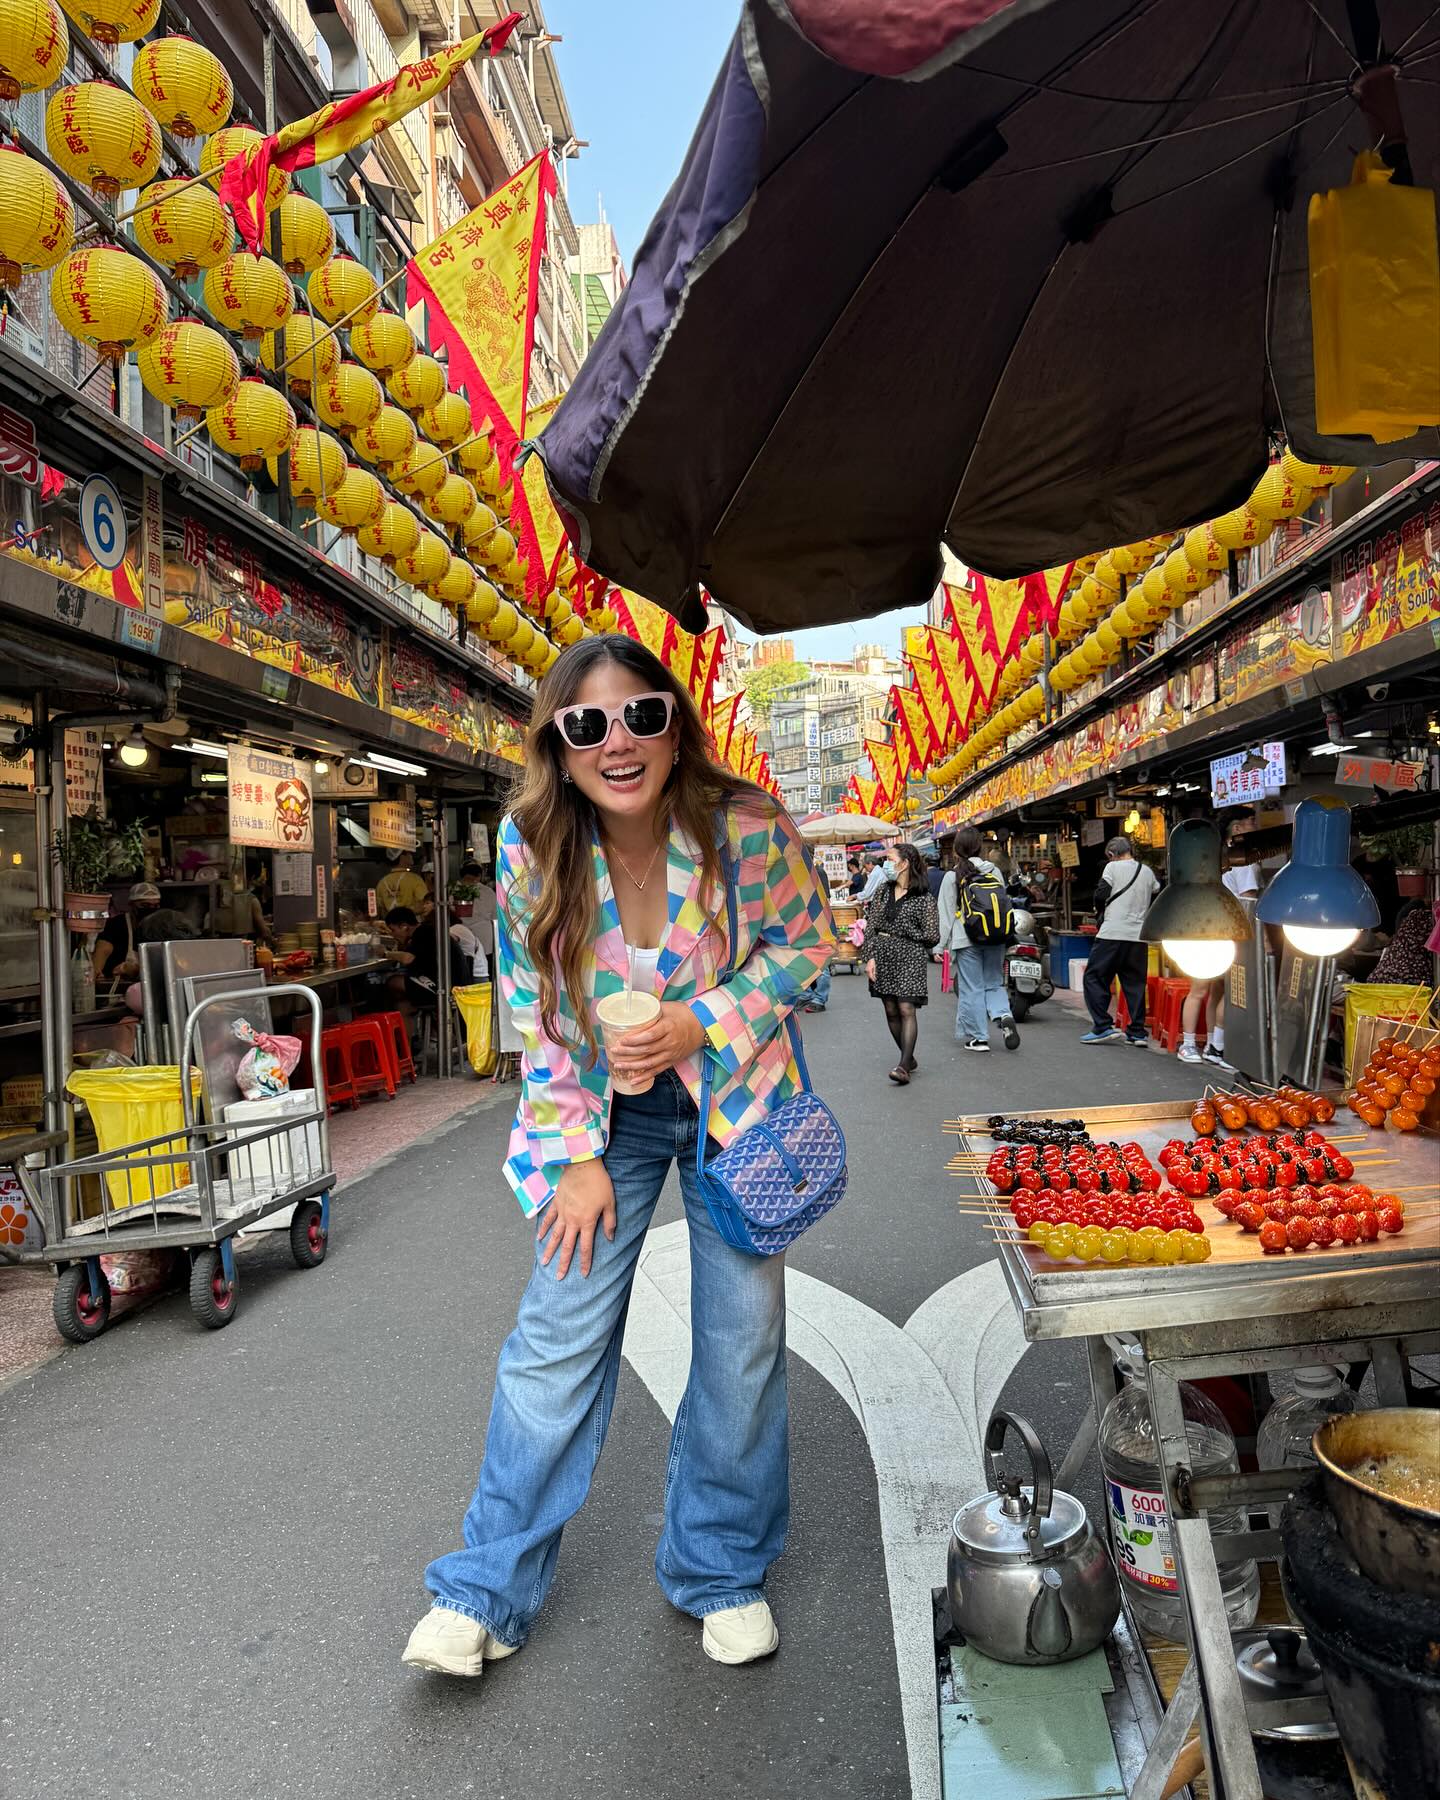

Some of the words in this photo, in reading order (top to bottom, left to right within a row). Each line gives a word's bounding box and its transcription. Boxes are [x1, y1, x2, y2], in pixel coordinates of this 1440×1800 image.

[92, 493, 116, 553] 6
[1408, 587, 1435, 612] Soup
[1343, 758, 1418, 786] 外帶區
